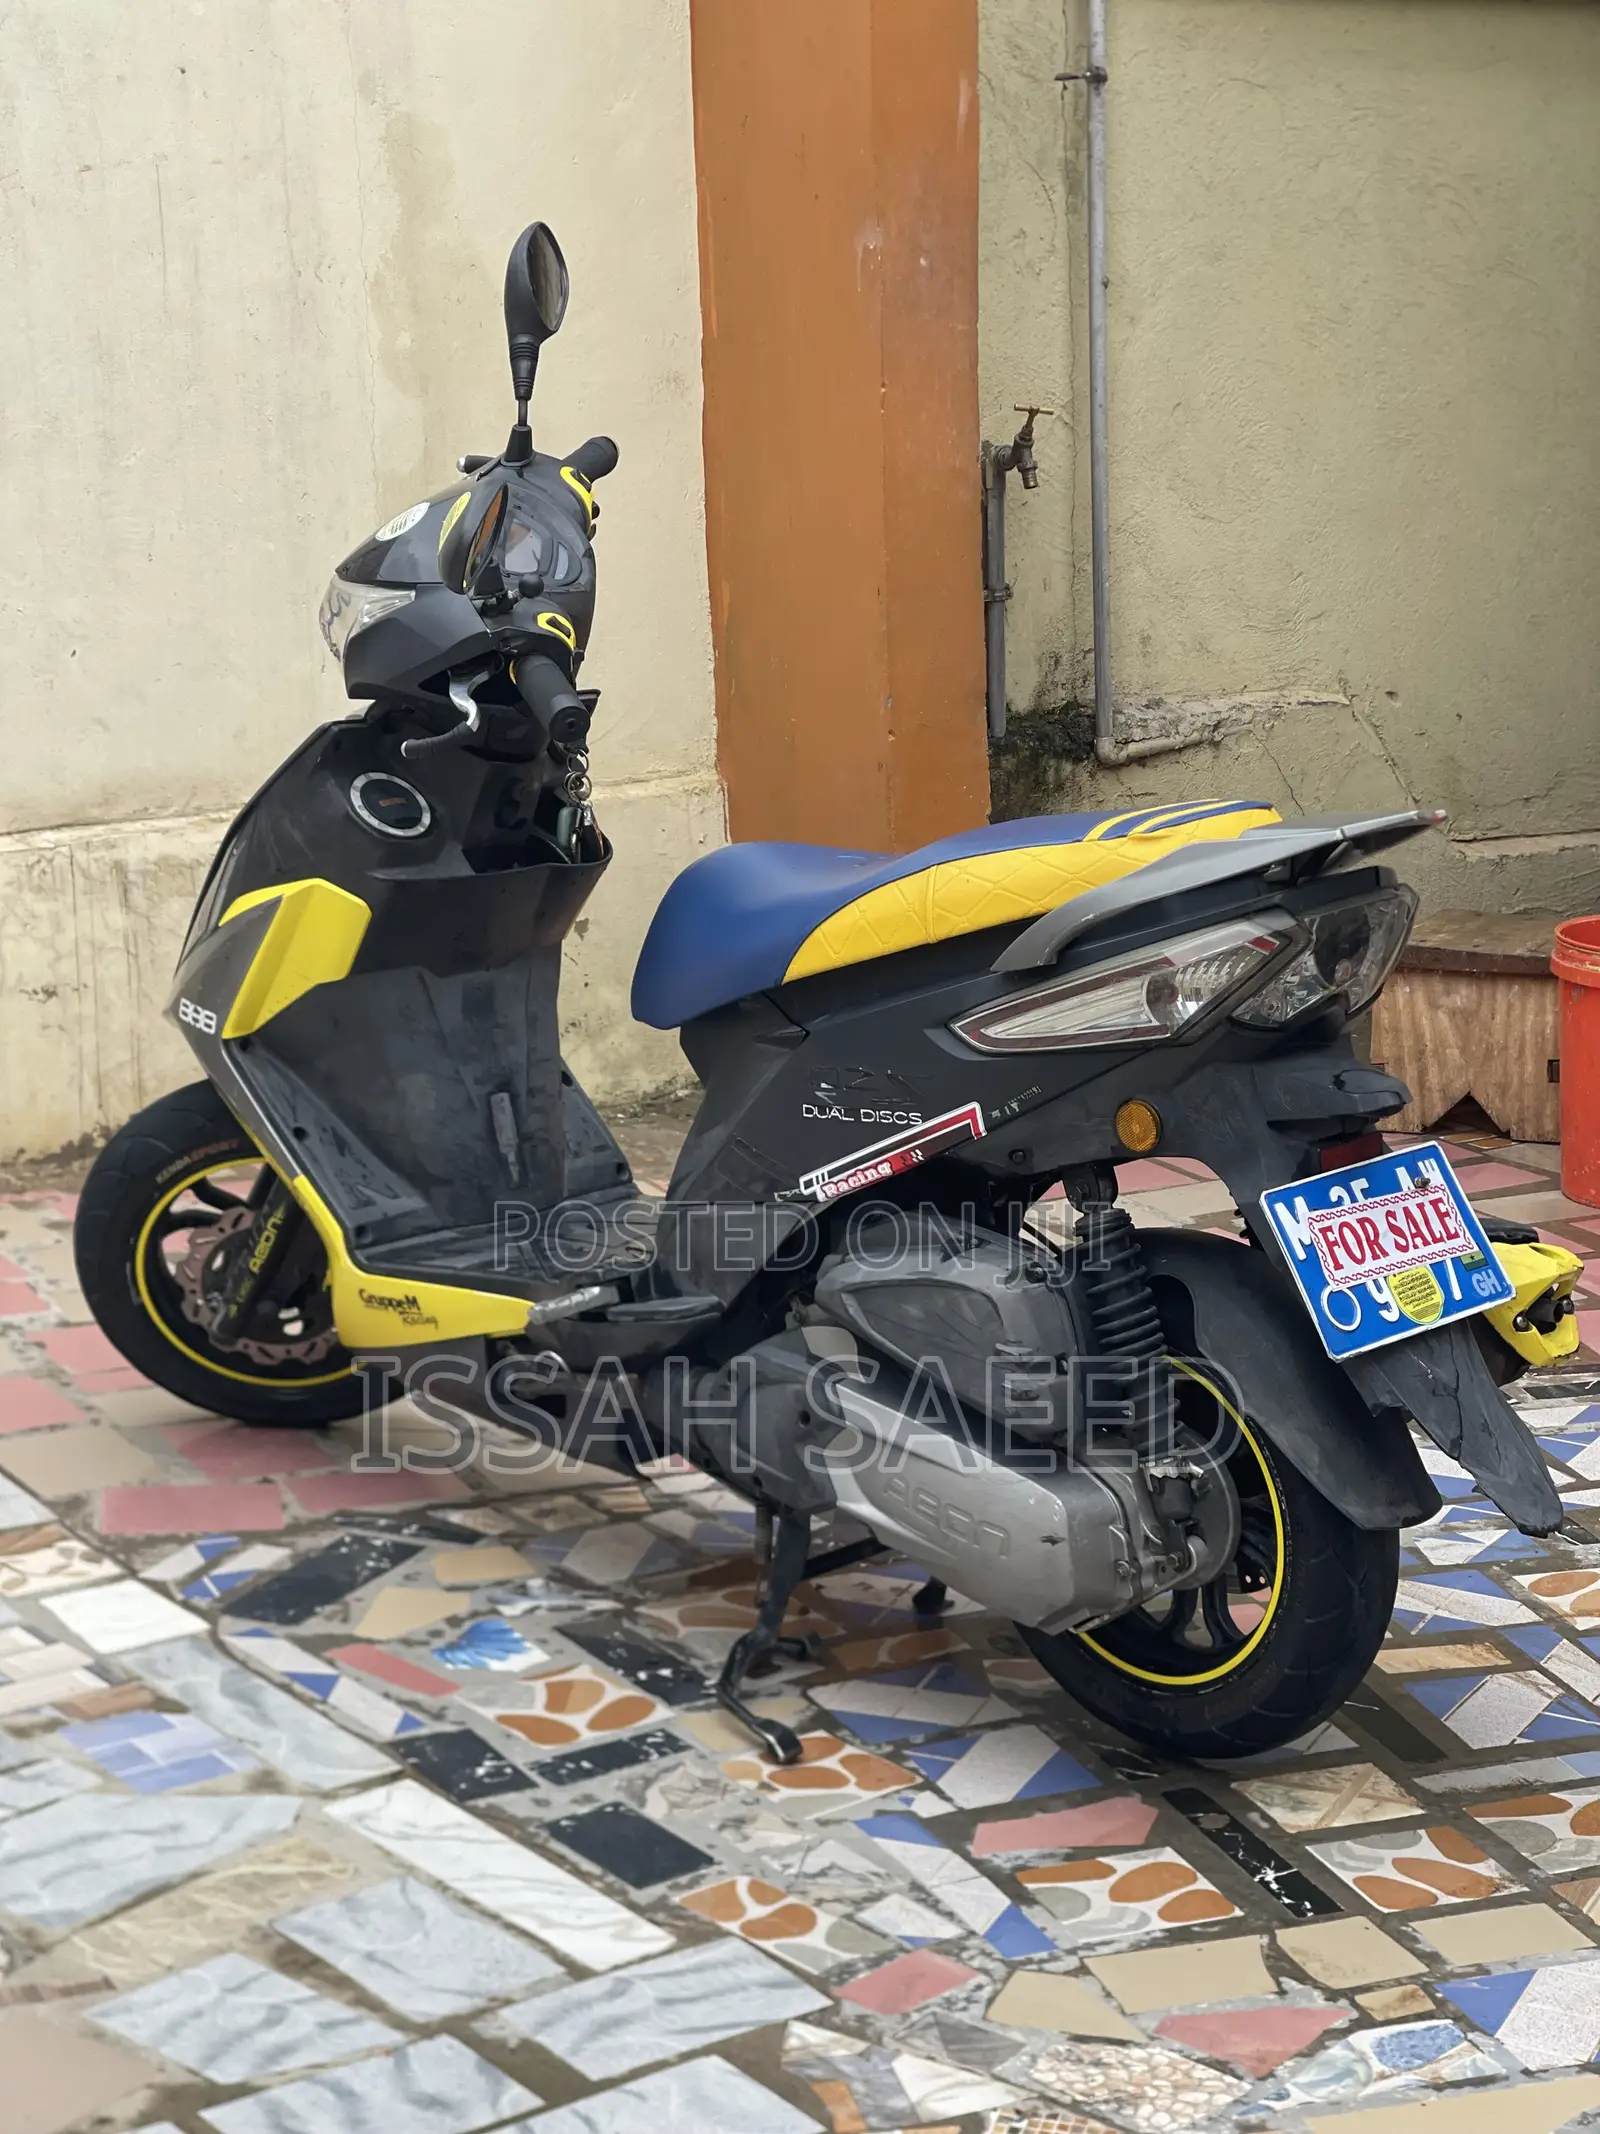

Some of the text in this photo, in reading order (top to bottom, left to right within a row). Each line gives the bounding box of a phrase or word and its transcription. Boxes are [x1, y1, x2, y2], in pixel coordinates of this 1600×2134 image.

[802, 1104, 923, 1125] DUAL DISCS
[821, 1161, 893, 1199] Racing
[1318, 1197, 1461, 1272] FOR SALE
[1471, 1268, 1503, 1298] GH
[358, 1288, 421, 1312] GruppeM
